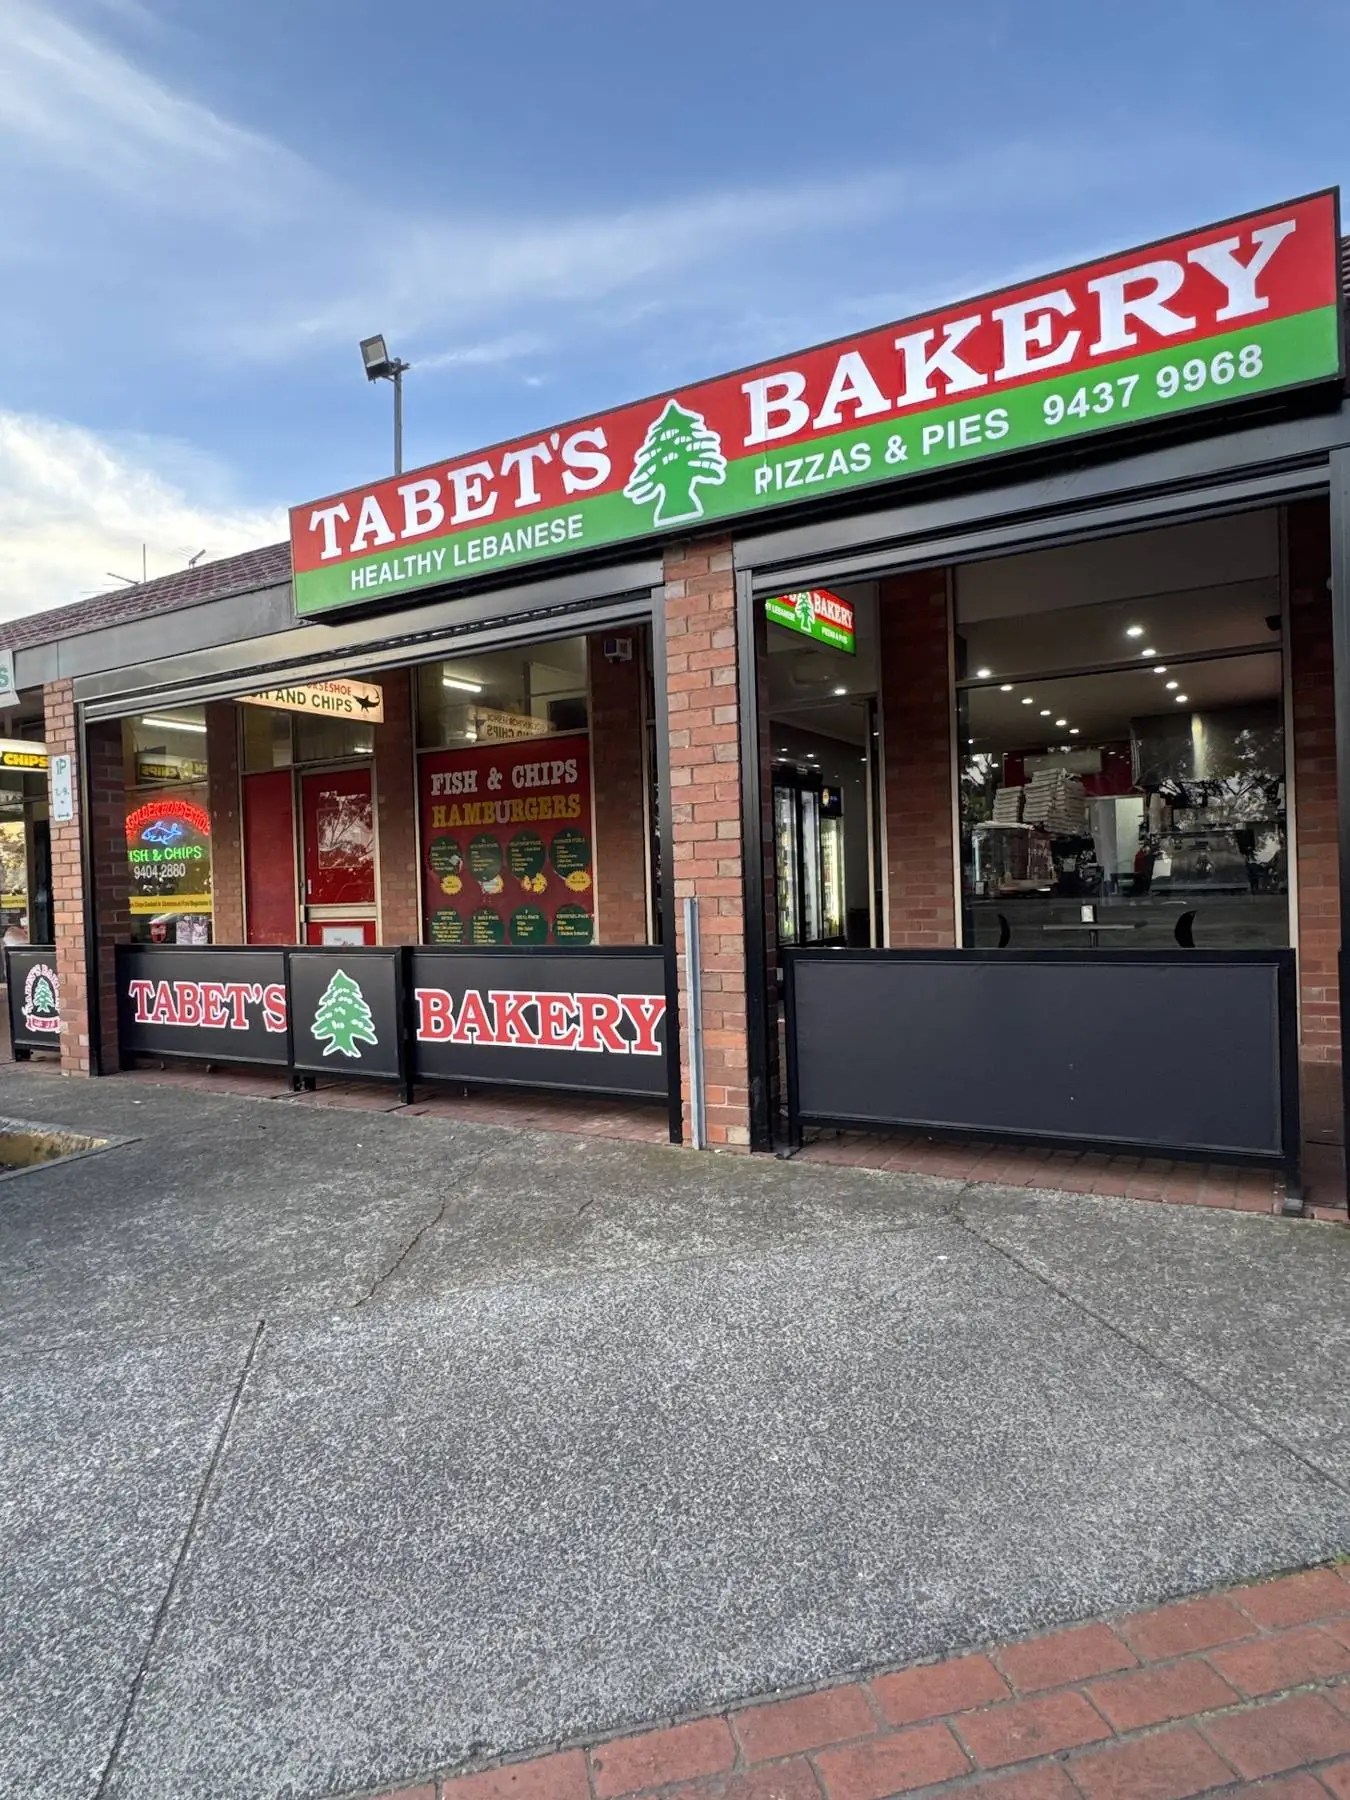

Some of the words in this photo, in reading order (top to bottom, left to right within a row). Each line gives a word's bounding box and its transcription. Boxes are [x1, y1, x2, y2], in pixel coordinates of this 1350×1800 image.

[309, 427, 612, 560] TABET'S
[741, 219, 1296, 447] BAKERY
[754, 442, 871, 495] PIZZAS
[884, 435, 908, 465] &
[922, 408, 1009, 456] PIES
[1043, 374, 1139, 426] 9437
[1156, 344, 1264, 400] 9968
[351, 548, 446, 590] HEALTHY
[453, 514, 584, 567] LEBANESE
[813, 591, 853, 629] BAKERY
[276, 688, 306, 705] AND
[312, 694, 352, 712] CHIPS
[4, 752, 48, 768] CHIPS
[430, 770, 478, 796] FISH
[487, 767, 503, 790] &
[512, 759, 578, 789] CHIPS
[432, 793, 581, 828] HAMBURGERS
[128, 849, 149, 862] ISH
[152, 848, 161, 861] &
[164, 846, 202, 860] CHIPS
[413, 988, 666, 1056] BAKERY
